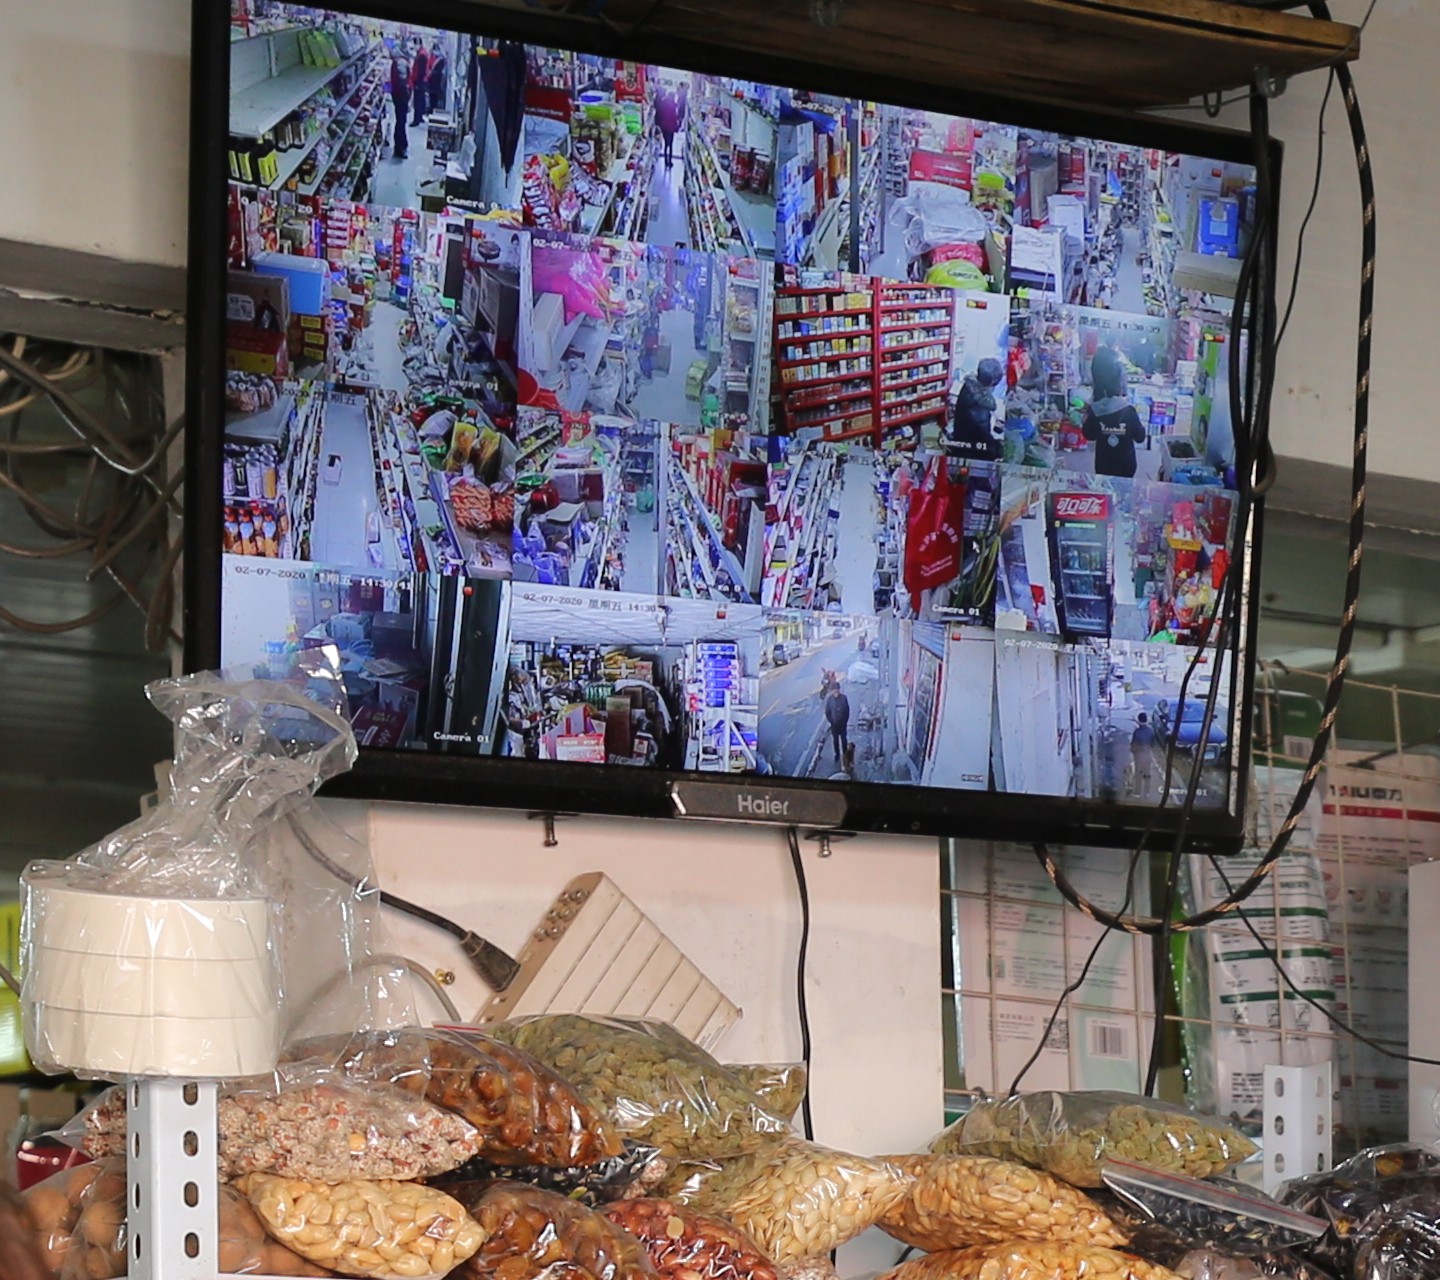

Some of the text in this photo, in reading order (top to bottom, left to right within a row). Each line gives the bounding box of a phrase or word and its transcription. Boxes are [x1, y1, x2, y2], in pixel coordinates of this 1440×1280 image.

[235, 566, 306, 579] 02-07-2020
[523, 592, 583, 606] 02-07-2020
[932, 604, 981, 616] Camera 01
[433, 732, 491, 743] Camera 01
[737, 794, 789, 815] Haier
